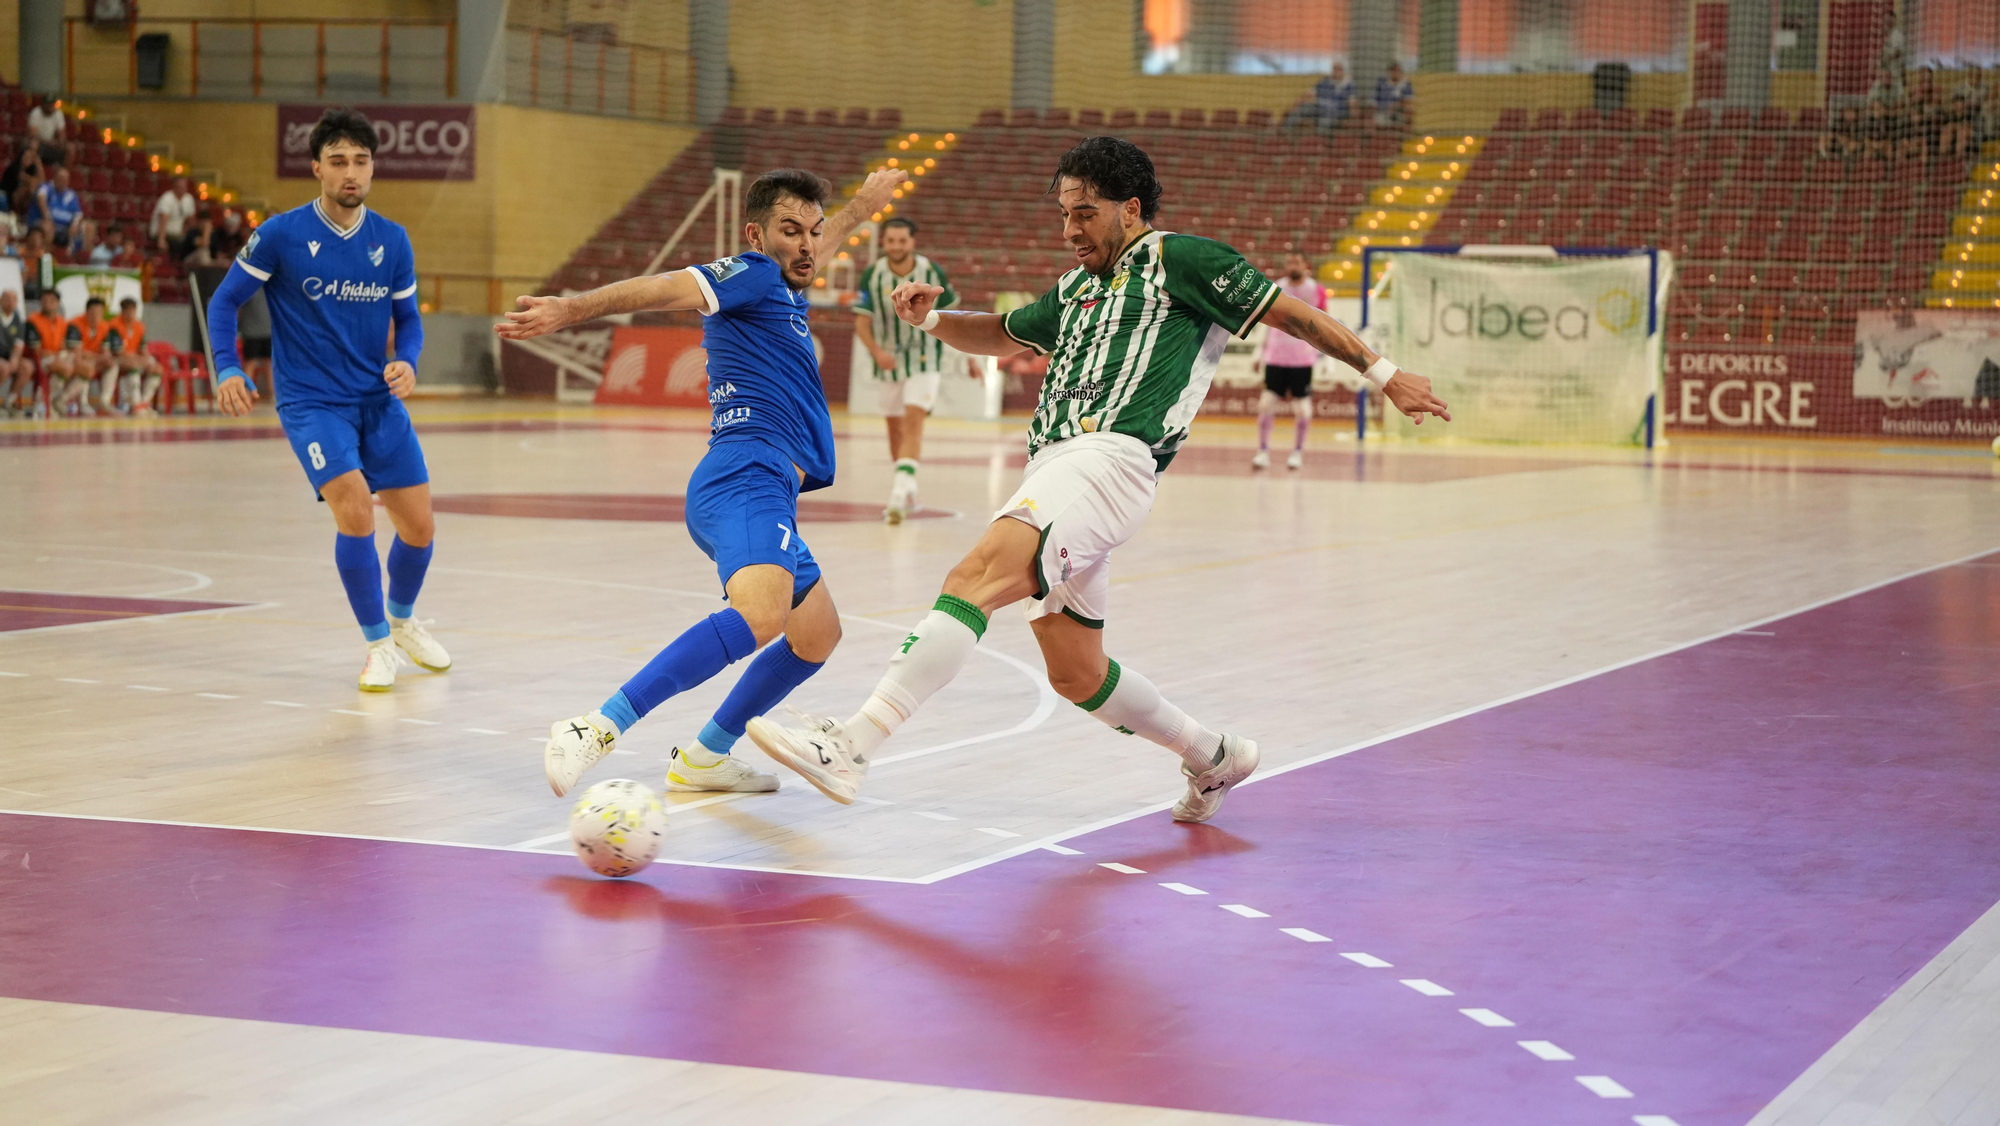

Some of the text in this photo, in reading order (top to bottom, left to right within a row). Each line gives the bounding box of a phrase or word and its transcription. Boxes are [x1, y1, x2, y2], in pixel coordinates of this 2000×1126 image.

[340, 279, 390, 303] hidalgo
[1417, 277, 1589, 349] Jabea
[1680, 352, 1788, 376] DEPORTES
[307, 441, 327, 471] 8
[777, 522, 791, 552] 7
